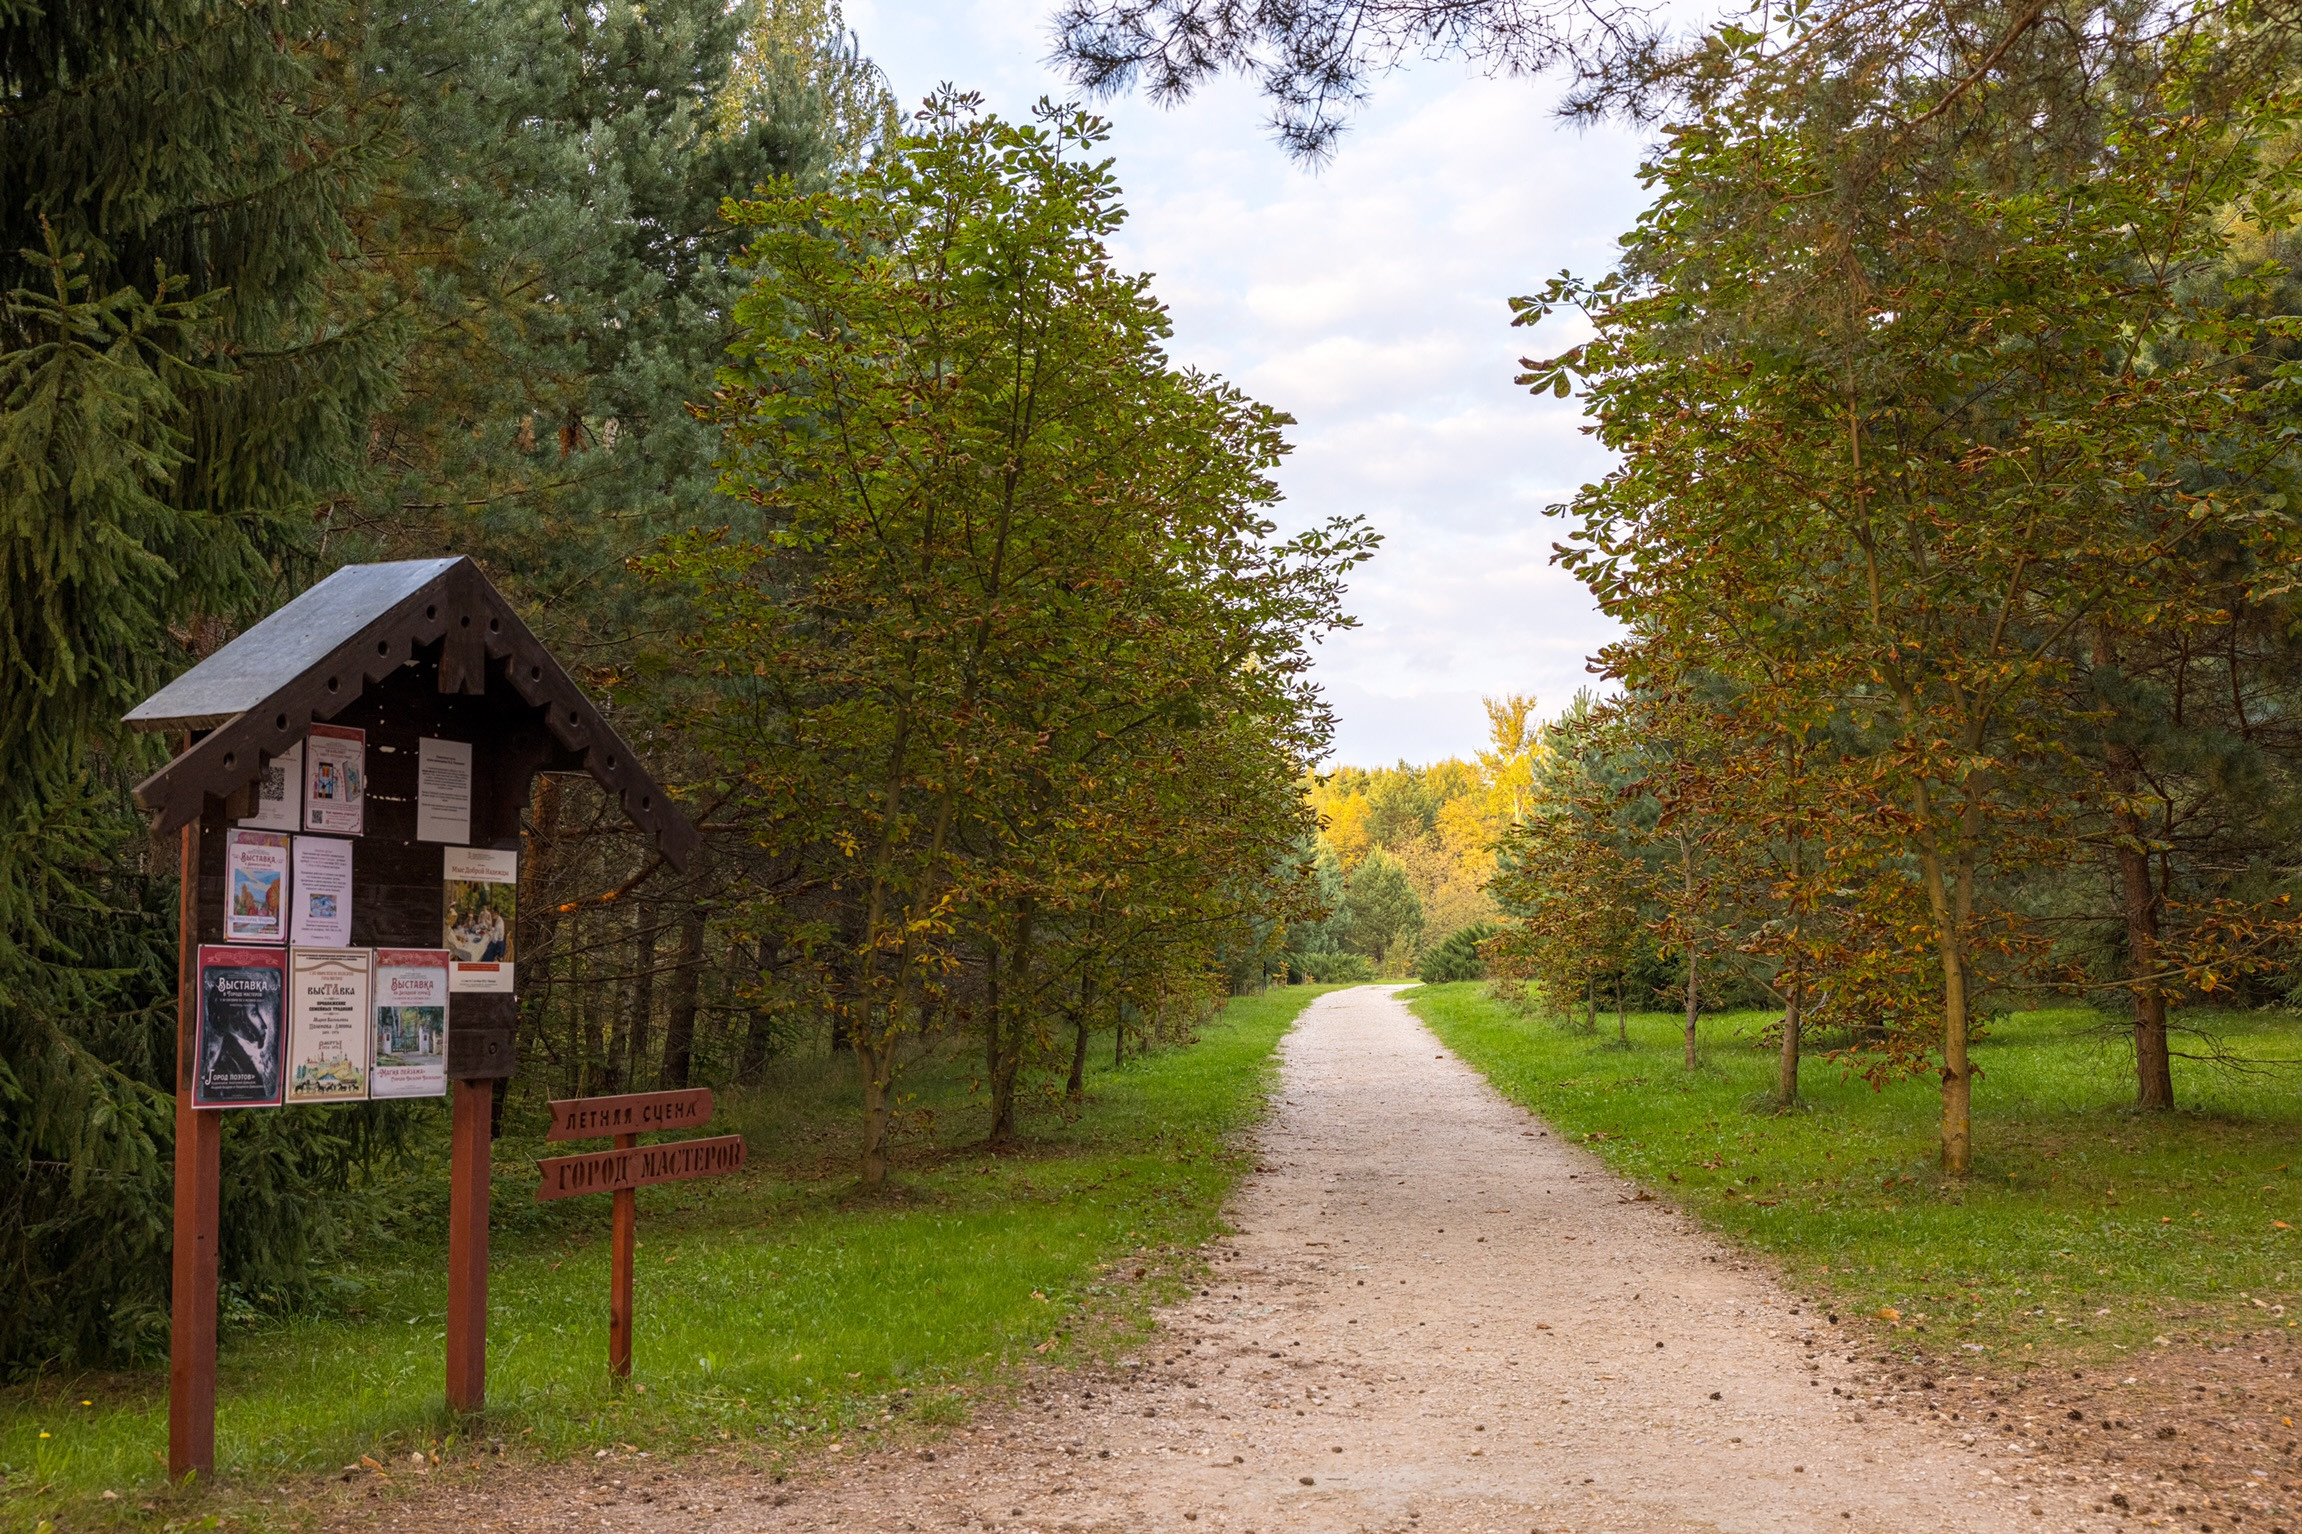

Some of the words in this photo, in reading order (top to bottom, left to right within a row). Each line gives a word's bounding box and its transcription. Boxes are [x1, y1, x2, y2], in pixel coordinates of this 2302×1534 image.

[217, 977, 268, 992] ВЫСТАВКА
[391, 977, 434, 992] ВЫСТАВКА
[565, 1107, 633, 1130] ЛЕТНЯЯ
[643, 1102, 697, 1123] СЦЕНА
[558, 1155, 629, 1190] ГОРОД
[641, 1142, 741, 1178] МАСТЕРОВ
